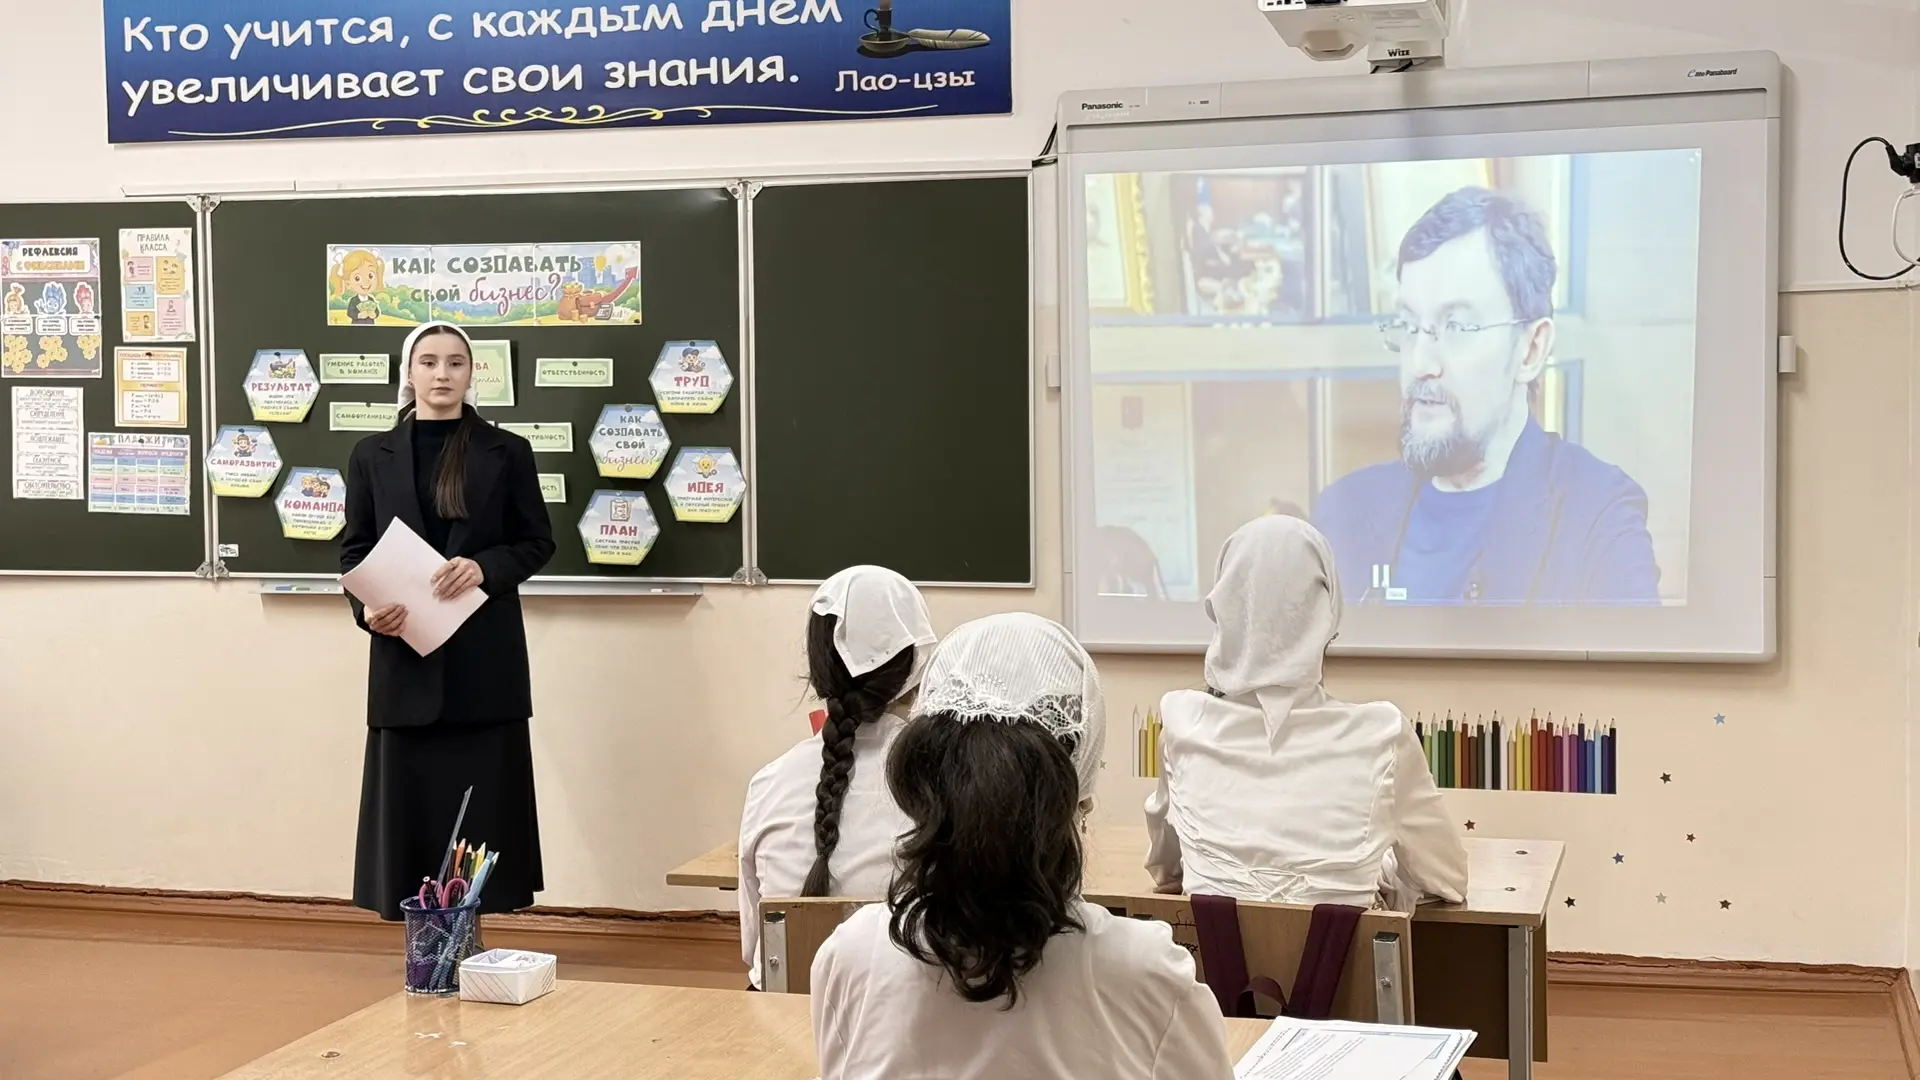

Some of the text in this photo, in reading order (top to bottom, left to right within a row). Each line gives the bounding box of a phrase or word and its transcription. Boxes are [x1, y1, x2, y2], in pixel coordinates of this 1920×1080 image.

[123, 16, 210, 52] Кто
[224, 16, 410, 60] учится,
[428, 13, 454, 41] с
[473, 3, 683, 39] каждым
[122, 55, 800, 117] увеличивает свои знания.
[835, 70, 976, 92] Лао-цзы
[1081, 102, 1123, 110] Panasonic
[137, 233, 170, 242] ПРАВИЛА
[22, 247, 78, 256] РЕФЛЕКСИЯ
[140, 243, 167, 253] КЛАССА
[393, 255, 582, 274] КАК СОЗДАВАТЬ
[411, 272, 561, 316] СВОЙ бизнес?
[252, 383, 312, 391] РЕЗУЛЬТАТ
[674, 376, 709, 387] ТРУД
[599, 428, 663, 436] СОЗДАВАТЬ
[616, 439, 645, 449] СВОЙ
[211, 459, 277, 468] САМОРАЗВИТИЕ
[602, 449, 657, 472] бизнес?
[688, 482, 724, 493] ИДЕЯ
[284, 500, 344, 512] КОМАНДА
[600, 525, 637, 536] ПЛАН
